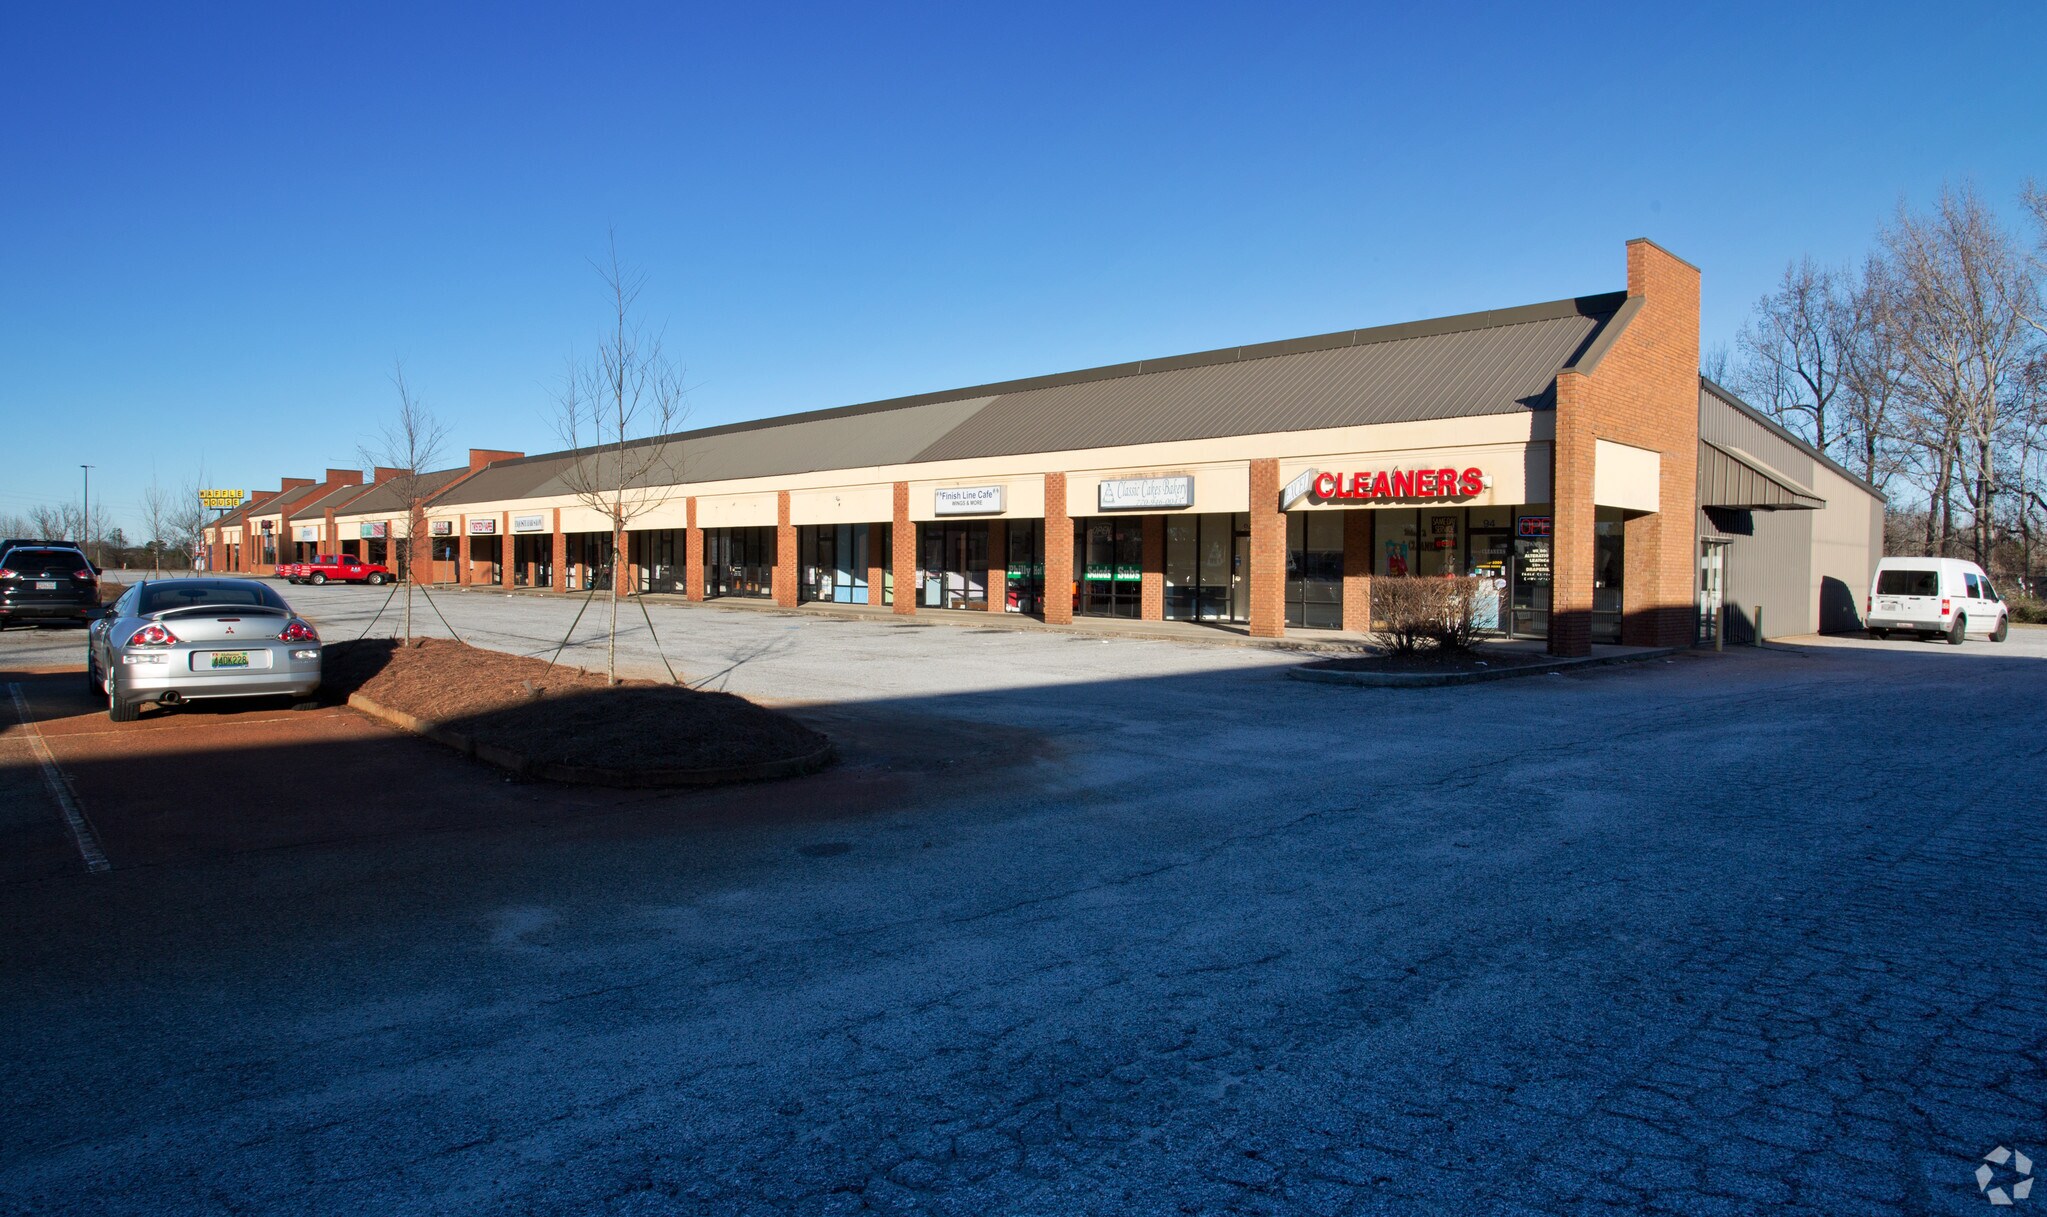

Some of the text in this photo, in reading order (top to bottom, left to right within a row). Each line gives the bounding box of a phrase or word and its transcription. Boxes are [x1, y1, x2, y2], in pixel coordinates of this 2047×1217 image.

[1117, 479, 1187, 499] Classic Cakes Bakery
[1314, 467, 1485, 499] CLEANERS
[962, 491, 976, 500] Line
[1521, 518, 1550, 535] OPE
[1008, 564, 1031, 577] Philly
[1087, 566, 1111, 579] Salads
[1117, 566, 1140, 579] Subs
